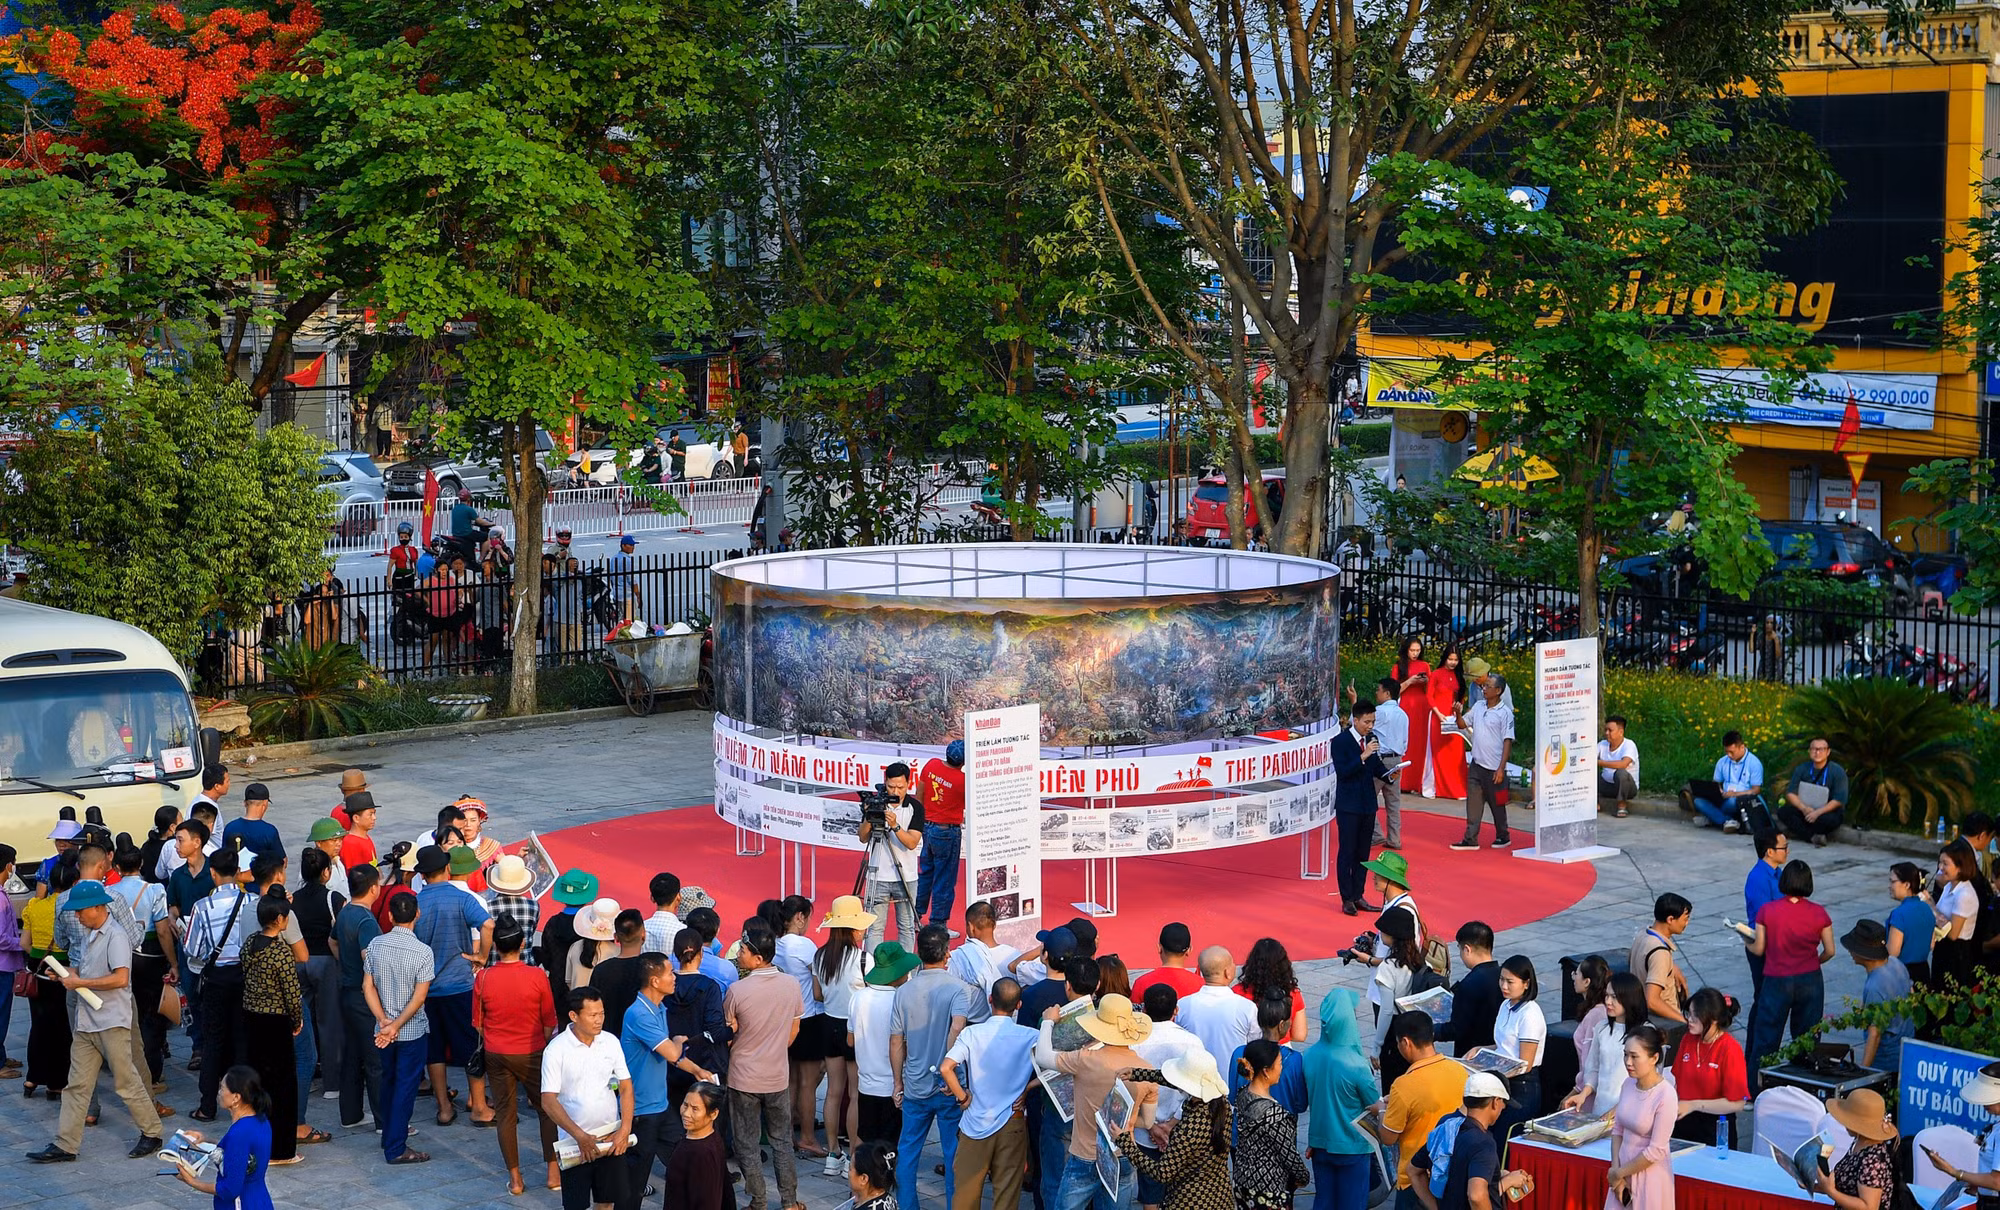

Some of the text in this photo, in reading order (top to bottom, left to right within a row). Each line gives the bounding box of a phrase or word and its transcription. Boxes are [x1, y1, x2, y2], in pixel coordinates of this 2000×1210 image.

[1870, 390, 1930, 405] 990.000
[174, 757, 184, 768] B
[725, 736, 747, 766] NIỆM
[752, 746, 766, 771] 70
[770, 748, 806, 779] NĂM
[814, 754, 869, 787] CHIẾN
[1226, 757, 1256, 784] THE
[1263, 741, 1328, 778] PANORAMA
[1096, 762, 1139, 792] PHỦ
[1917, 1060, 1948, 1084] QUÝ
[1908, 1086, 1929, 1110] TỰ
[1932, 1089, 1963, 1116] BẢO
